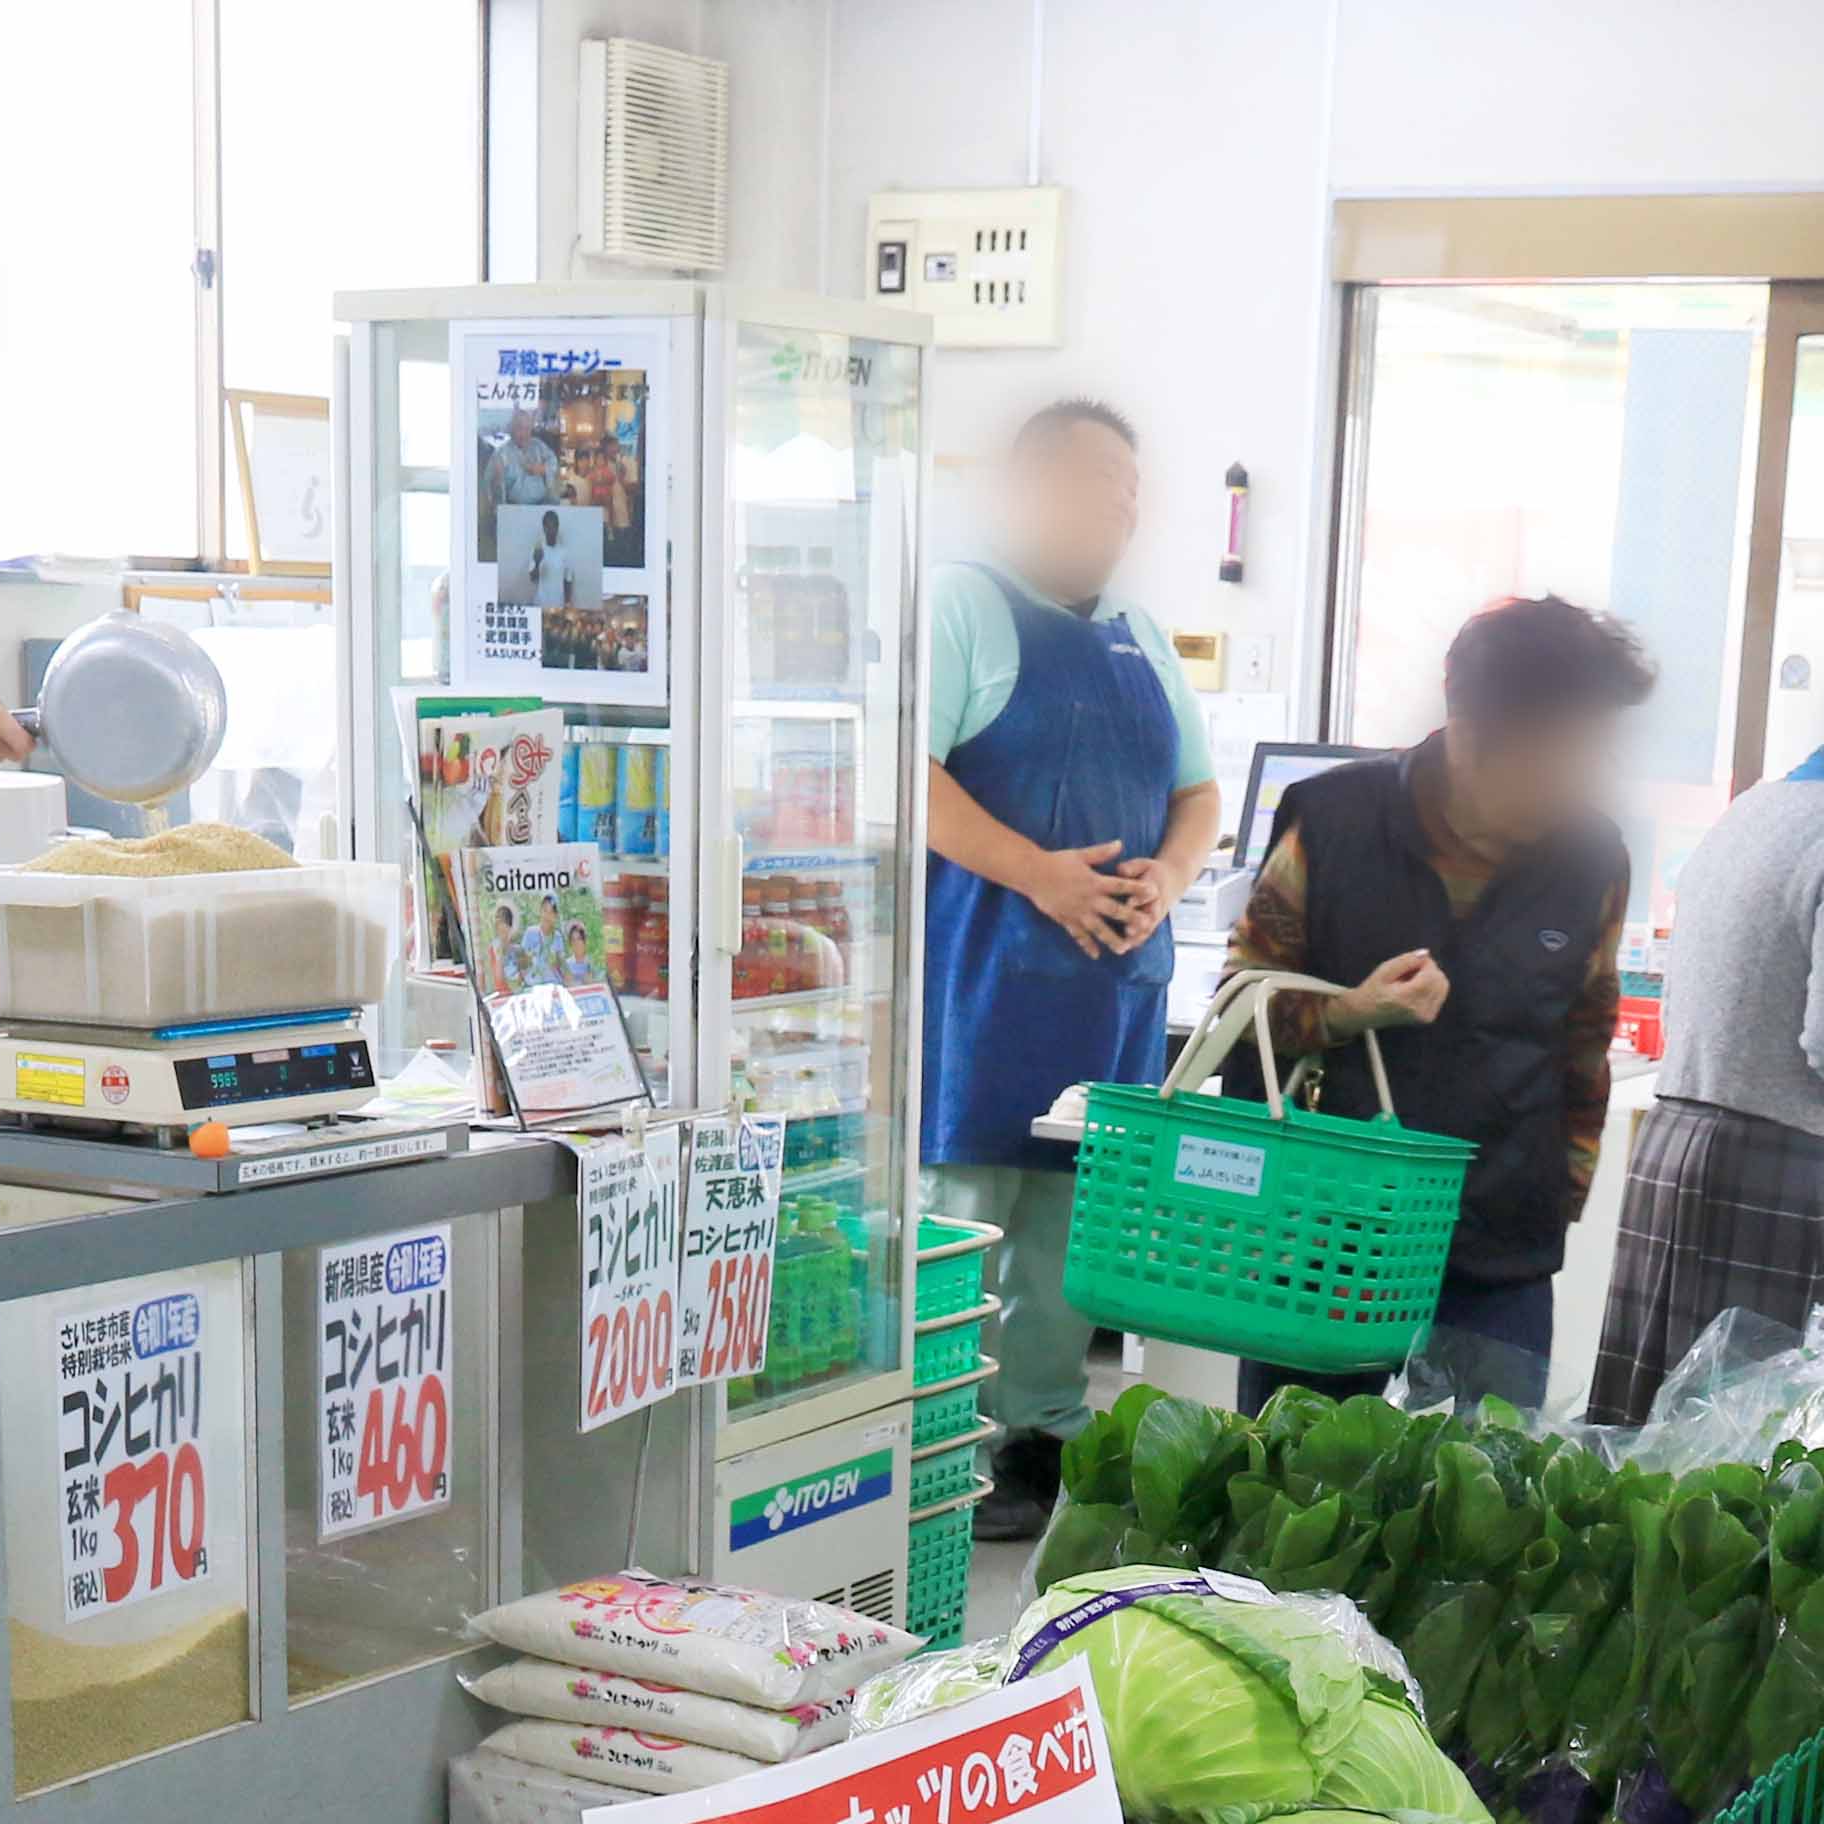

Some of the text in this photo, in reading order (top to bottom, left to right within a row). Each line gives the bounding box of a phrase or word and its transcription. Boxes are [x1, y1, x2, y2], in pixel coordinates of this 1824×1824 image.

[498, 349, 623, 377] 房総エナジー
[485, 864, 571, 893] Saitama
[705, 1174, 768, 1212] 天恵米
[588, 1180, 676, 1289] コシヒカリ
[687, 1217, 775, 1258] コシヒカリ
[323, 1251, 385, 1304] 新潟県産
[59, 1310, 132, 1349] さいたま市産
[323, 1289, 446, 1395] コシヒカリ
[60, 1342, 133, 1379] 特別栽培米
[61, 1351, 201, 1472] コシヒカリ
[326, 1400, 357, 1446] 玄米
[329, 1447, 354, 1480] 1kg
[66, 1476, 102, 1526] 玄米
[792, 1467, 862, 1518] ITO EN
[71, 1527, 99, 1569] 1kg
[1054, 1595, 1119, 1634] 新鮮野菜
